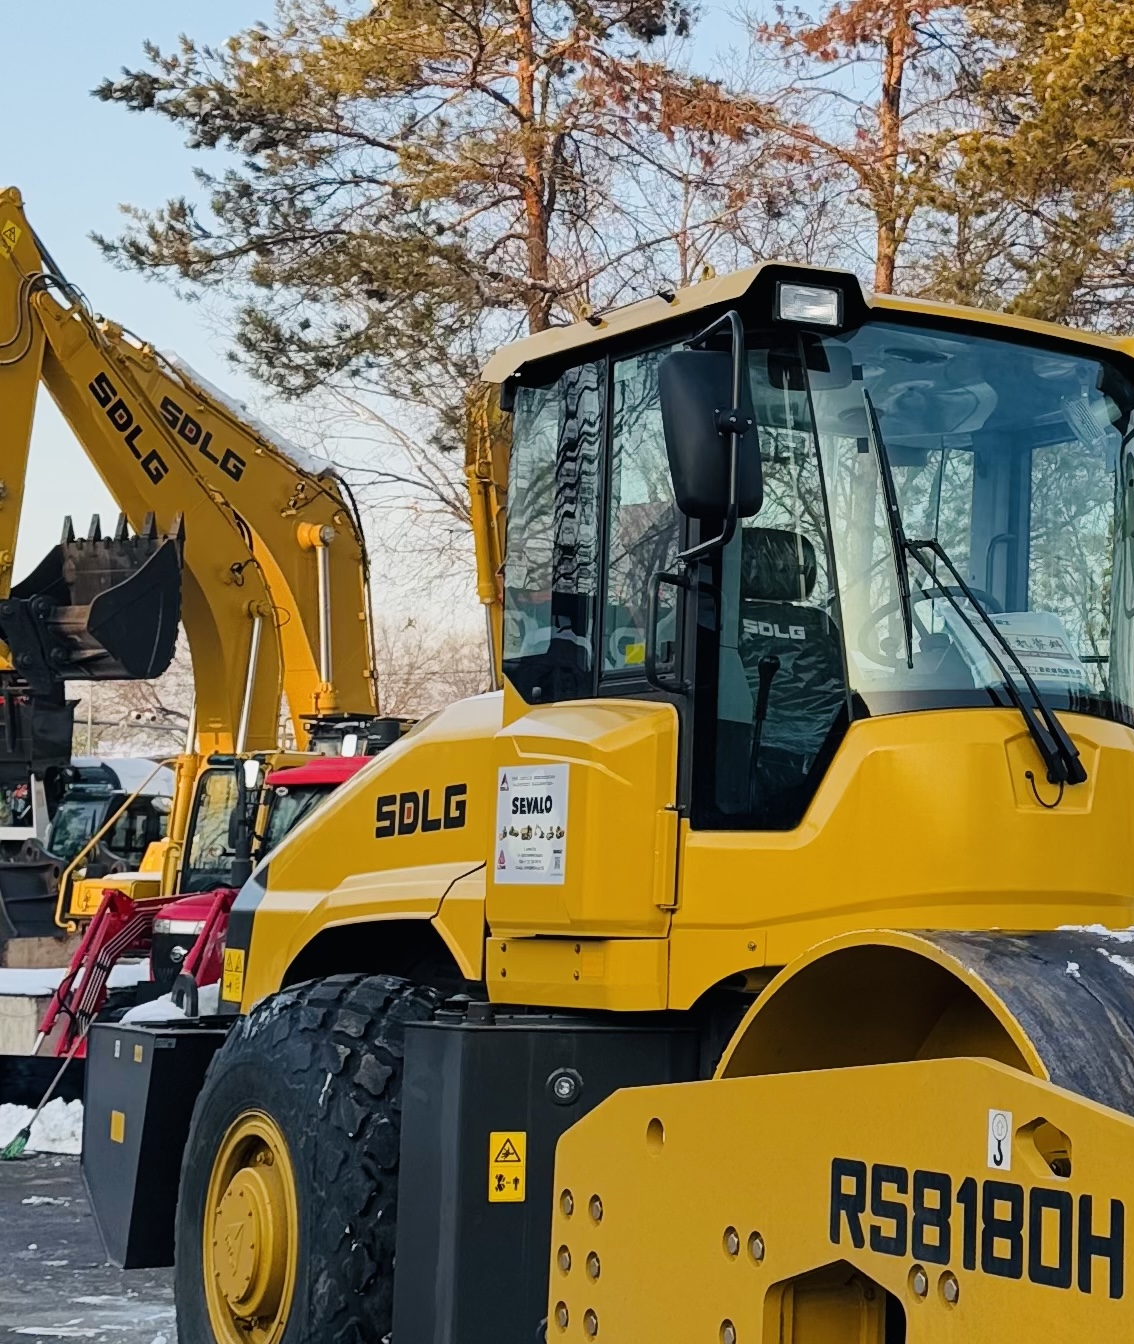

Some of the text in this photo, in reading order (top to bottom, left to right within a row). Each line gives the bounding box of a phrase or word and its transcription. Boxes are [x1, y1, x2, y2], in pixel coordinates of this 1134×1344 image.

[88, 371, 170, 485] SDLG
[159, 395, 247, 482] SDLG
[743, 618, 806, 640] SDLG
[375, 783, 467, 839] SDLG
[511, 795, 553, 815] SEVALO
[829, 1157, 1125, 1300] RS8180H
